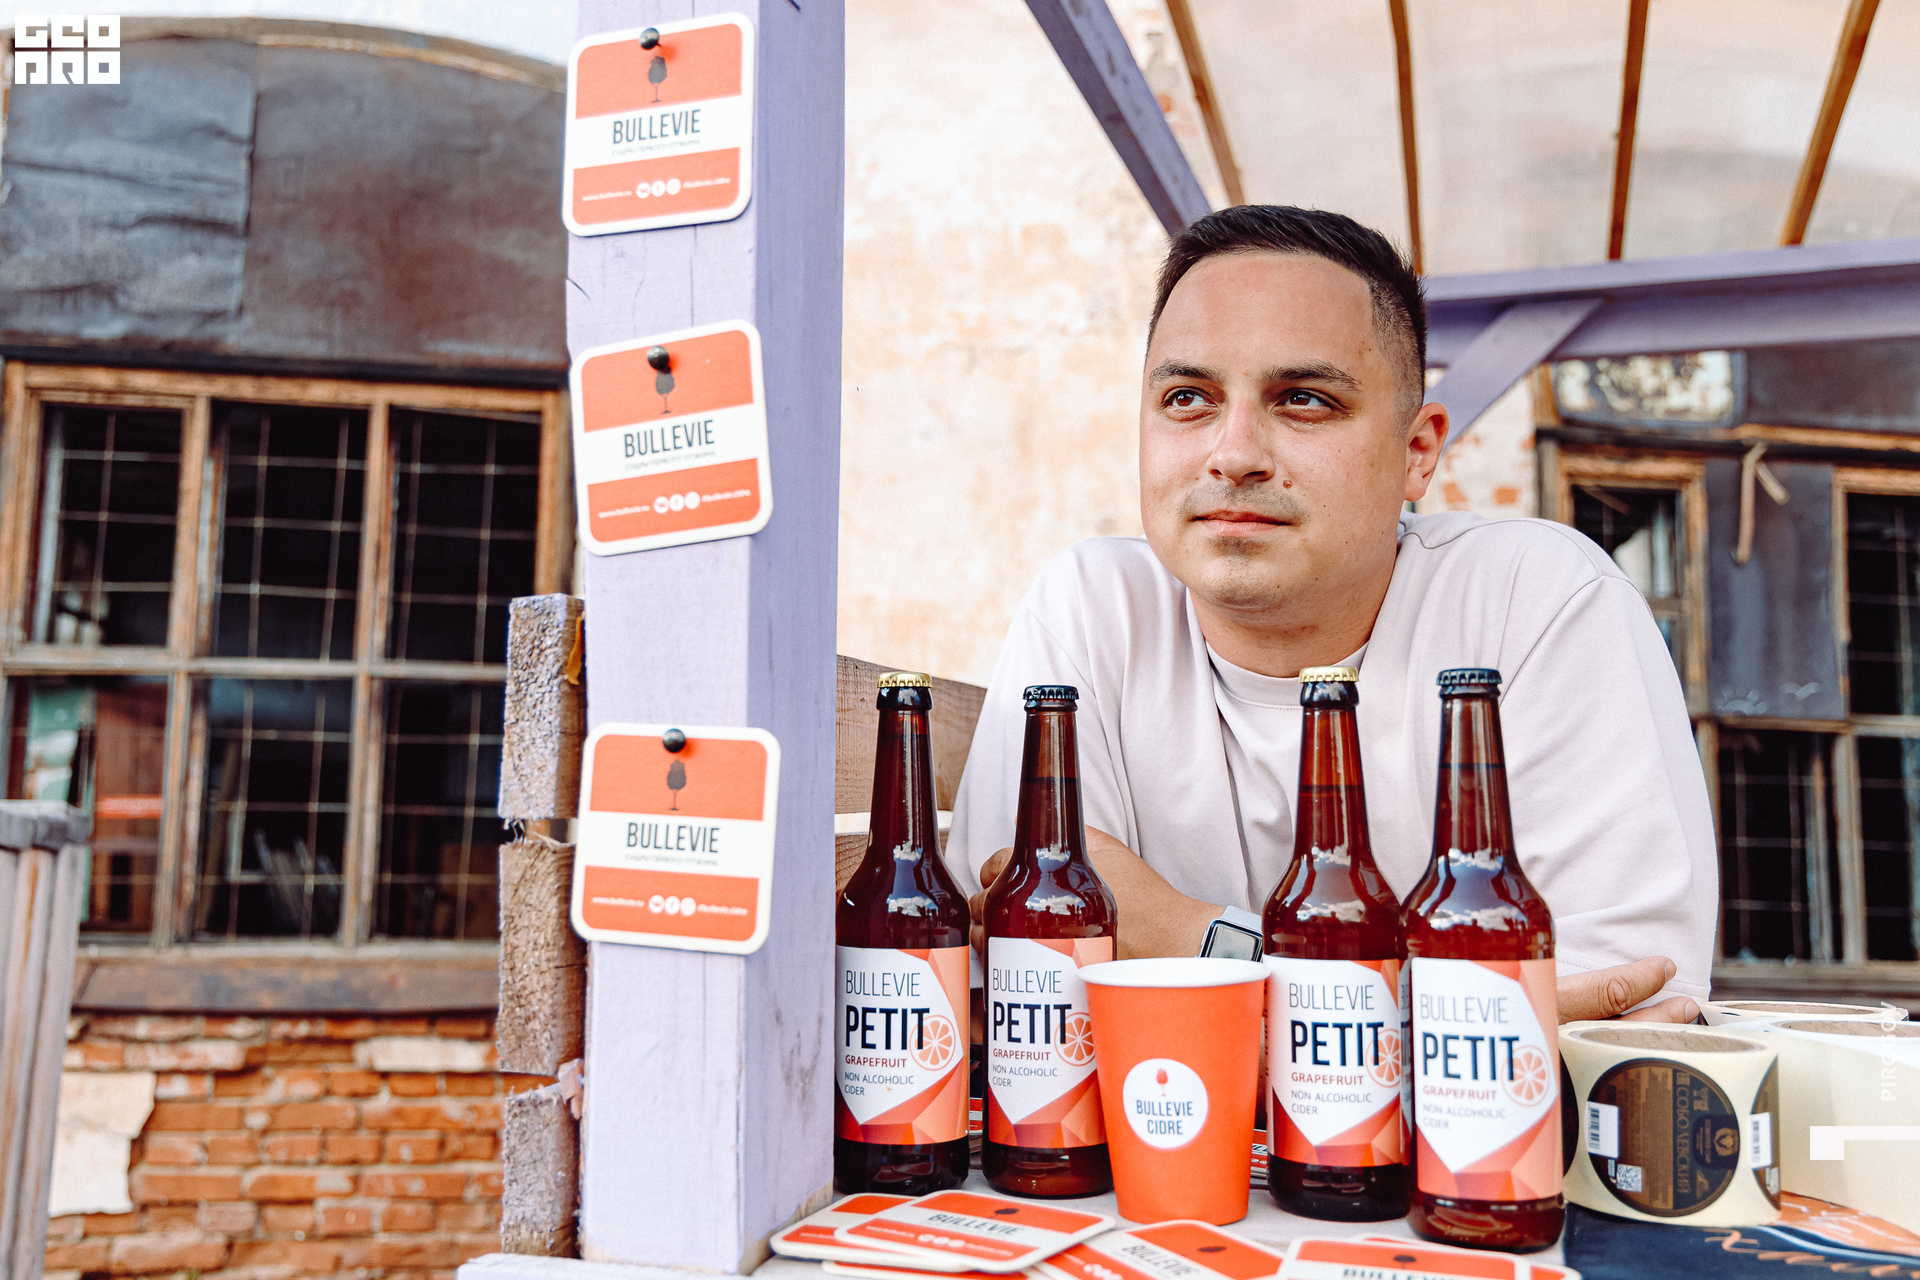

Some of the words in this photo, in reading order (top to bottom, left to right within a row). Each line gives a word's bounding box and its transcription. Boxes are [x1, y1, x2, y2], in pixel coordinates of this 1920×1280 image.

[613, 109, 701, 145] BULLEVIE
[624, 419, 714, 458] BULLEVIE
[627, 822, 720, 853] BULLEVIE
[846, 970, 920, 996] BULLEVIE
[992, 968, 1063, 993] BULLEVIE
[1289, 983, 1375, 1010] BULLEVIE
[1420, 993, 1508, 1023] BULLEVIE
[845, 1004, 930, 1050] PETIT
[993, 1001, 1072, 1044] PETIT
[1291, 1019, 1384, 1066] PETIT
[845, 1054, 907, 1068] GRAPEFRUIT
[993, 1048, 1051, 1061] GRAPEFRUIT
[1422, 1032, 1519, 1081] PETIT
[844, 1071, 860, 1082] NON
[862, 1074, 914, 1085] ALCOHOLIC
[992, 1064, 1007, 1074] NON
[1009, 1067, 1058, 1077] ALCOHOLIC
[1291, 1072, 1364, 1085] GRAPEFRUIT
[844, 1084, 865, 1096] CIDER
[992, 1076, 1012, 1087] CIDER
[1291, 1090, 1311, 1101] NON
[1315, 1092, 1372, 1103] ALCOHOLIC
[1423, 1085, 1497, 1100] GRAPEFRUIT
[1136, 1099, 1193, 1117] BULLEVIE
[1291, 1103, 1318, 1115] CIDER
[1423, 1103, 1442, 1115] NON
[1446, 1107, 1506, 1119] ALCOHOLIC
[1147, 1119, 1183, 1135] CIDRE
[1423, 1117, 1449, 1129] CIDER
[928, 1213, 1024, 1235] BULLEVIE
